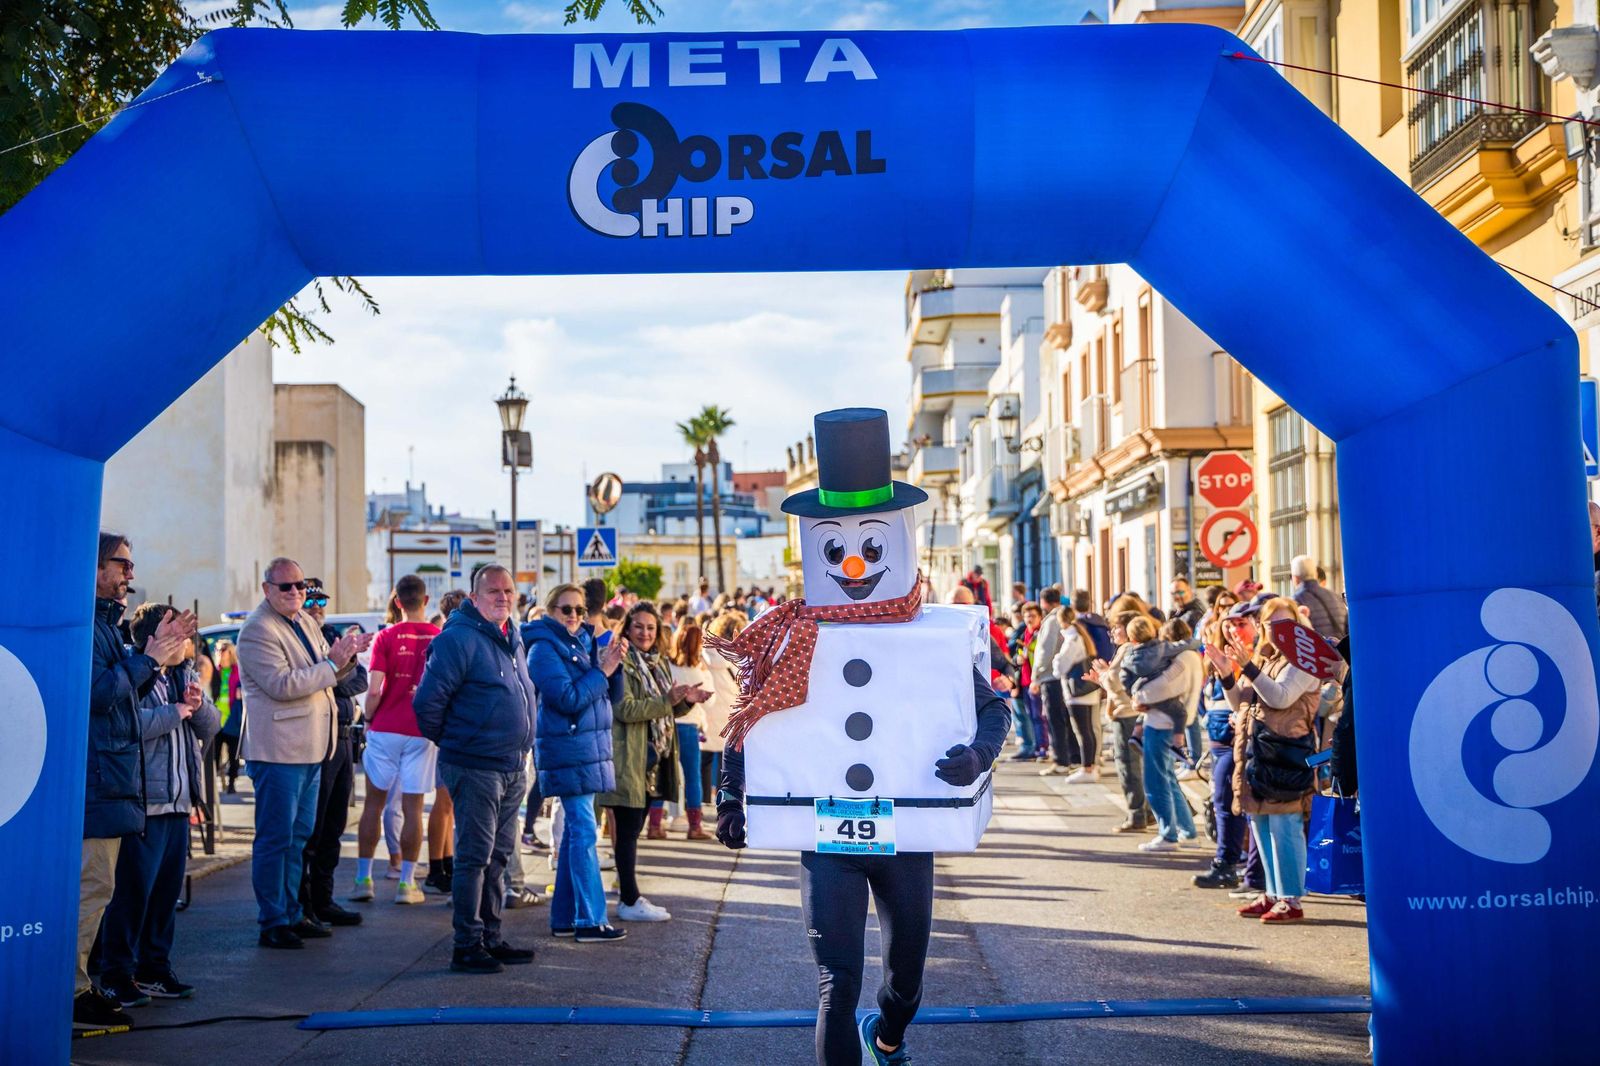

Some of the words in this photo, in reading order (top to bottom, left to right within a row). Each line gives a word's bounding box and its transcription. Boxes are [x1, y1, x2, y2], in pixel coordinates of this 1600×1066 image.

[573, 38, 878, 88] META
[1199, 473, 1252, 489] STOP
[1294, 626, 1317, 673] STOP
[837, 819, 876, 840] 49
[841, 845, 867, 853] cajasur
[1, 922, 43, 942] p.es
